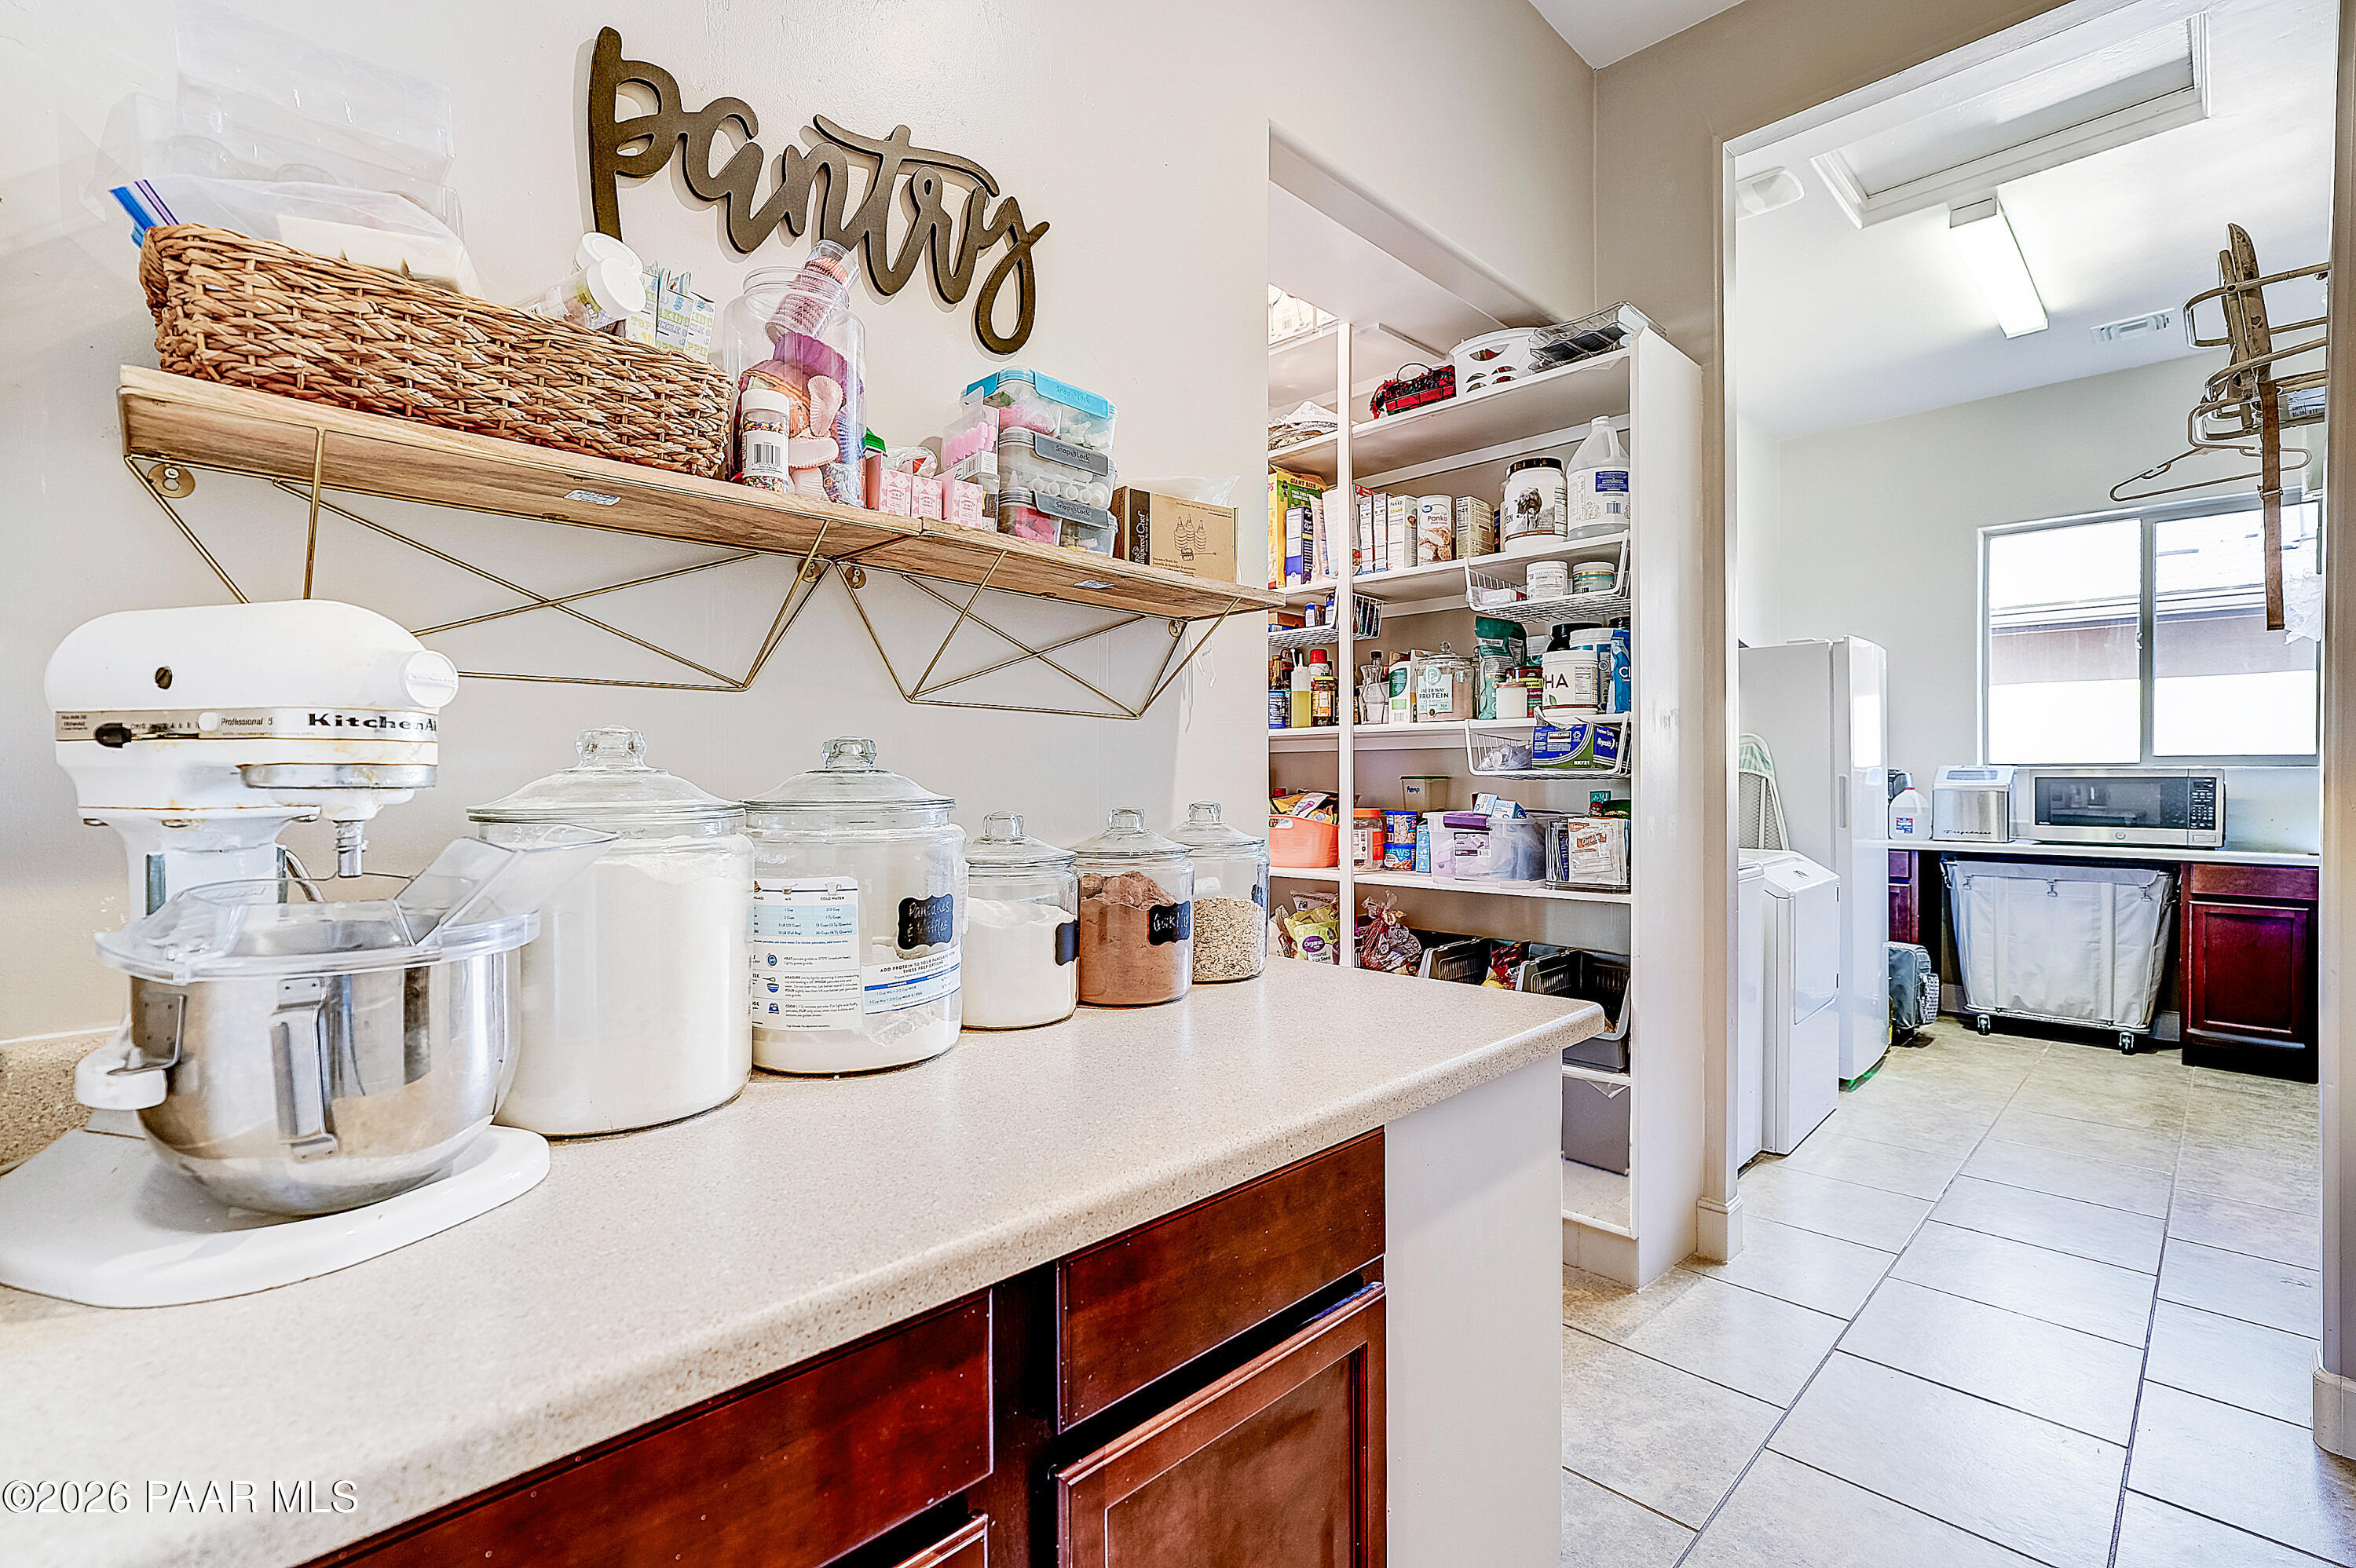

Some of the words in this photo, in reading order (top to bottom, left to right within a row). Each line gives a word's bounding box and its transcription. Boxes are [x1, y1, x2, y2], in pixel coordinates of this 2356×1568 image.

[589, 26, 1050, 355] pantry
[1055, 386, 1071, 398] Snap
[1077, 394, 1090, 404] Lock
[1055, 445, 1071, 457] Snap
[1077, 451, 1090, 462] Lock
[1290, 478, 1306, 487] GIANT
[1056, 501, 1070, 514] Snap
[1077, 507, 1090, 517] Lock
[1136, 510, 1146, 533] Chef
[221, 718, 263, 726] Professional
[307, 713, 437, 732] KitchenAi
